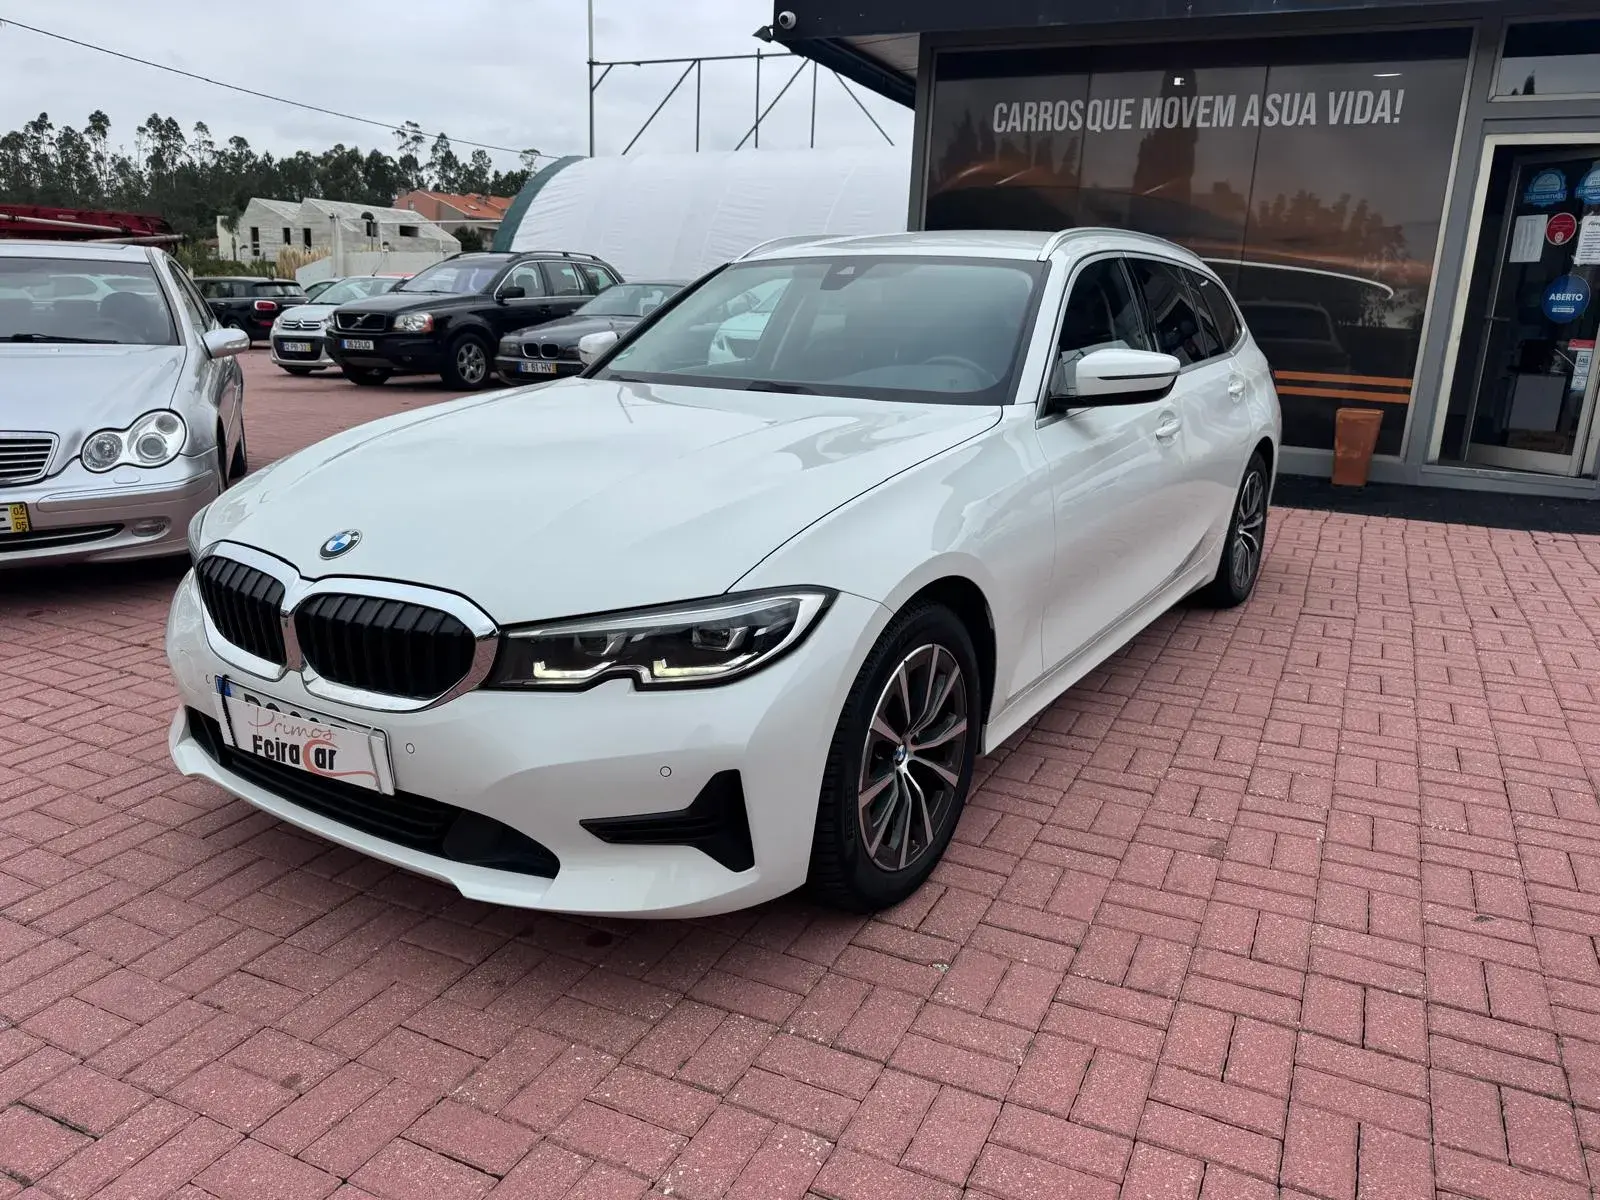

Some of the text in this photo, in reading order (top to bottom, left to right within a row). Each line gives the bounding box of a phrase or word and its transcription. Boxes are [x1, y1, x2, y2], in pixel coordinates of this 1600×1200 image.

[993, 89, 1405, 133] CARROS QUE MOVEM A SUA VIDA!
[1549, 293, 1584, 302] ABERTO
[13, 506, 25, 516] 02
[15, 521, 28, 530] 05
[248, 707, 336, 741] Primos
